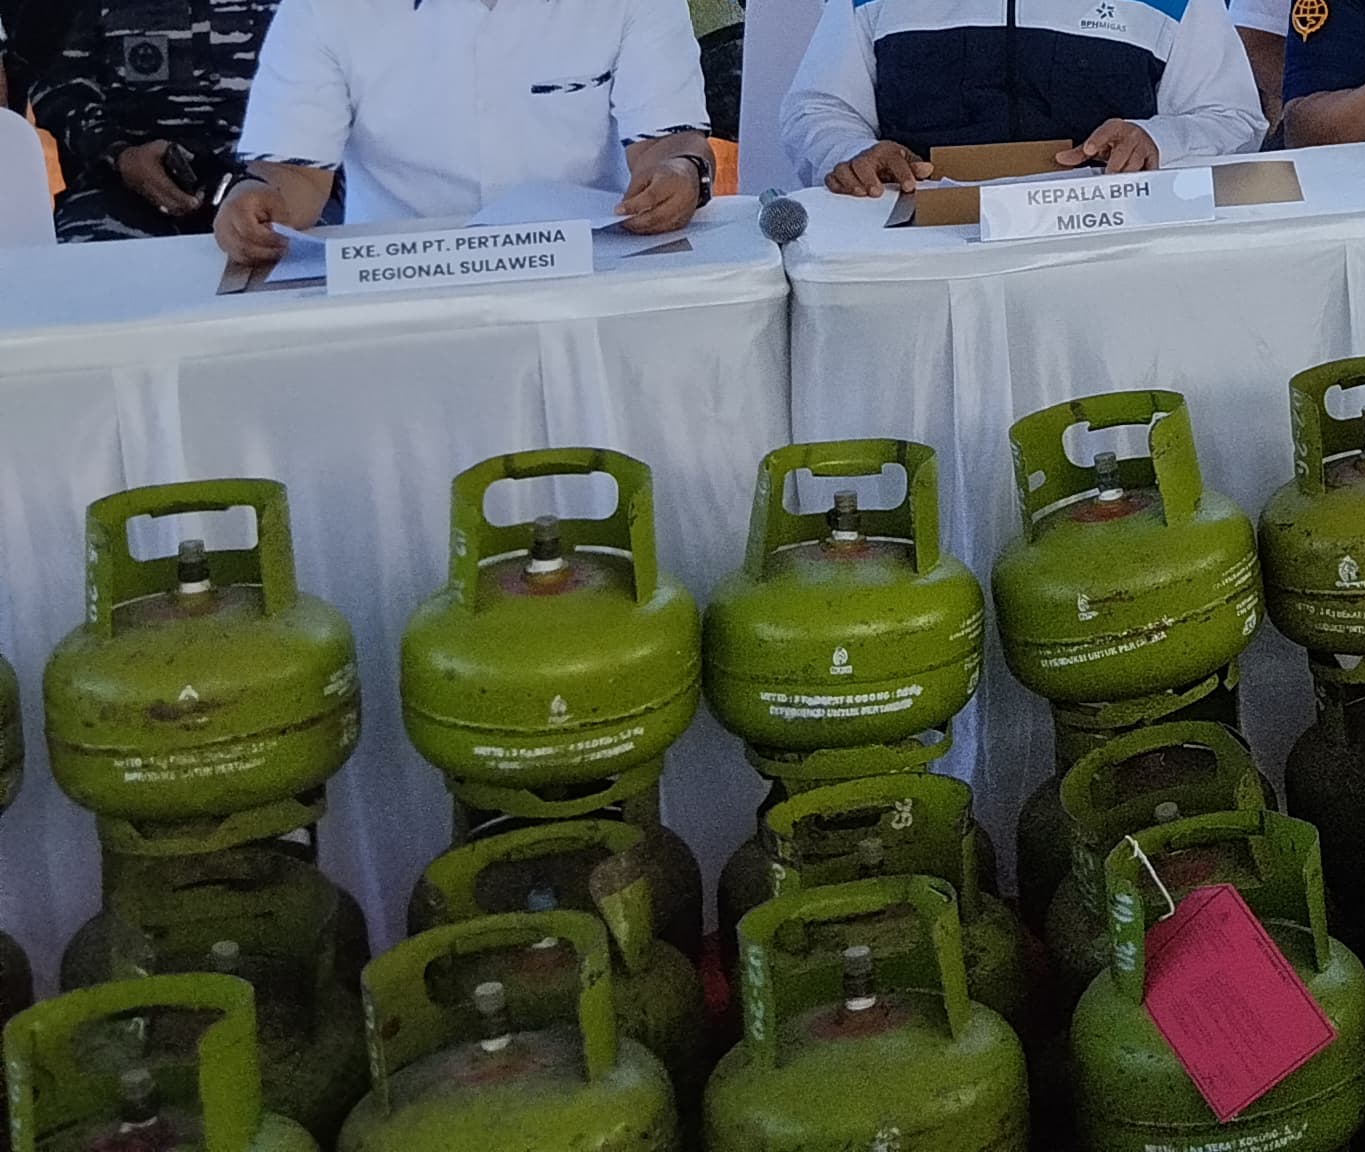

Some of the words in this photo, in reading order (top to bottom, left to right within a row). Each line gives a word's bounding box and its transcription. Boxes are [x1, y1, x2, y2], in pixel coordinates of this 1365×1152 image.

[1027, 185, 1104, 206] KEPALA
[1110, 181, 1150, 200] BPH
[1057, 212, 1124, 231] MIGAS
[341, 246, 380, 260] EXE.
[386, 242, 417, 256] GM
[423, 239, 450, 254] PT.
[456, 229, 566, 251] PERTAMINA
[359, 262, 455, 283] REGIONAL
[460, 254, 556, 274] SULAWESI
